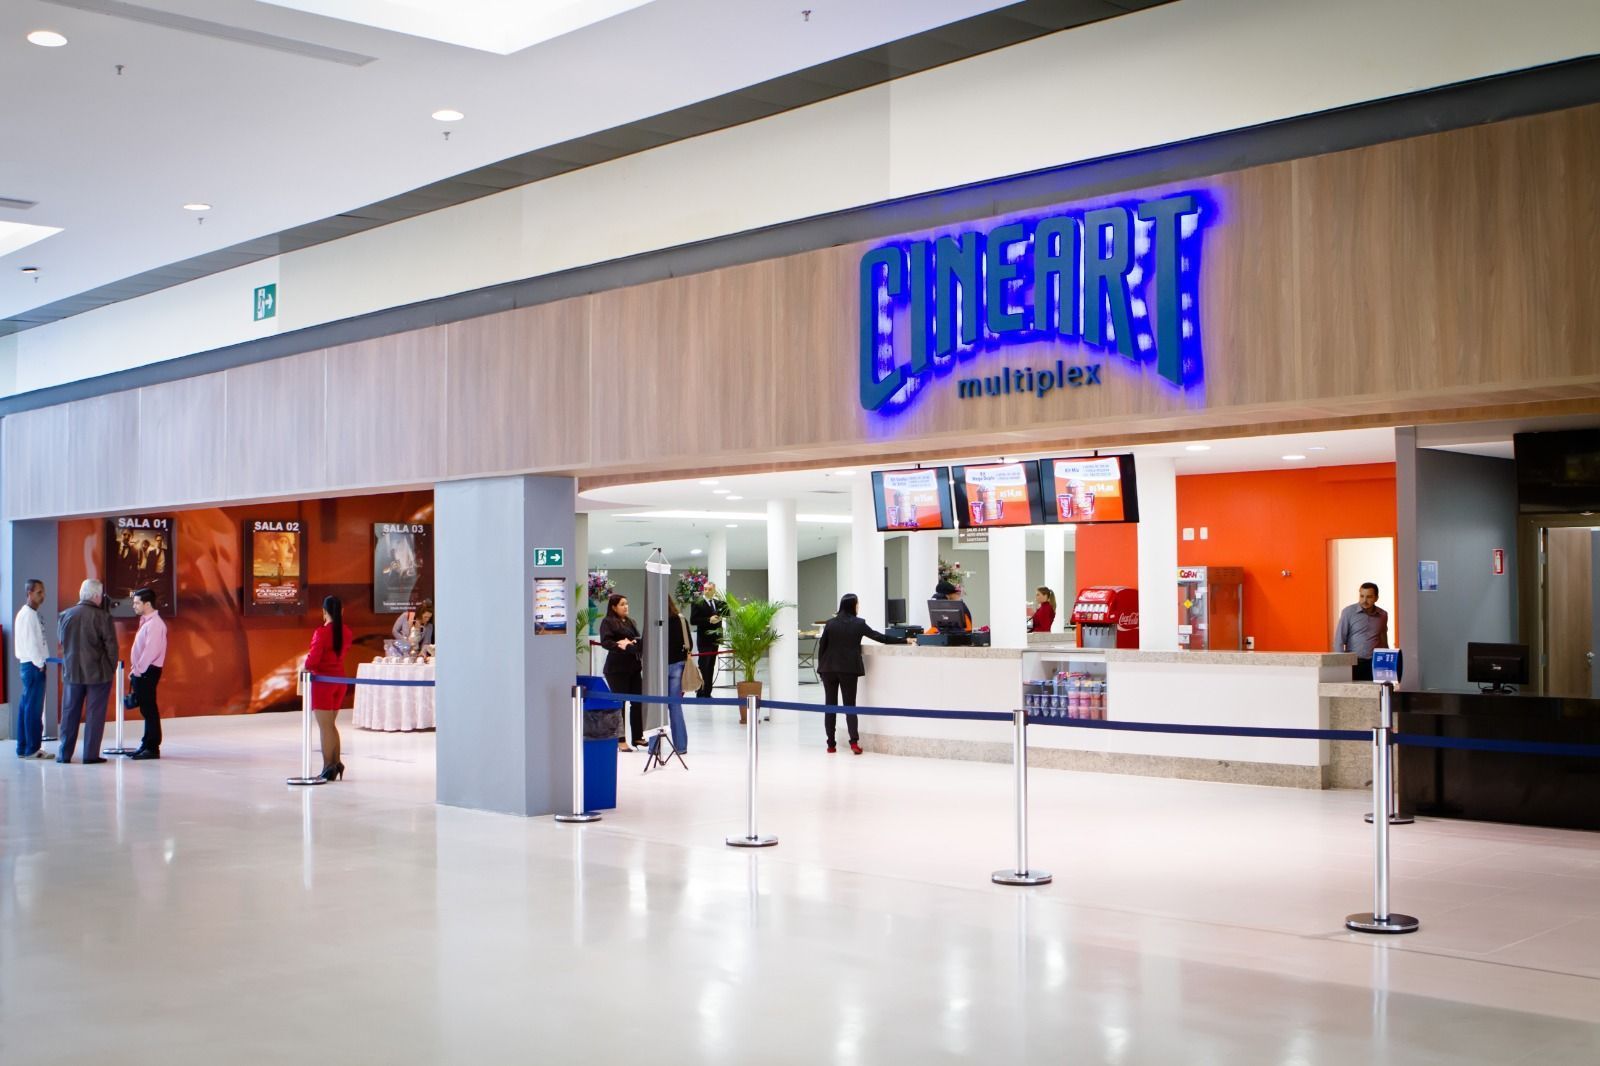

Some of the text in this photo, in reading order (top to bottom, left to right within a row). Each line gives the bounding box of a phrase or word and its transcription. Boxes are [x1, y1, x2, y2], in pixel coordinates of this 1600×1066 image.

[860, 195, 1195, 411] CINEART
[957, 360, 1101, 398] multiplex
[118, 518, 167, 529] SALA 01
[254, 521, 299, 531] SALA 02
[383, 524, 424, 533] SALA 03
